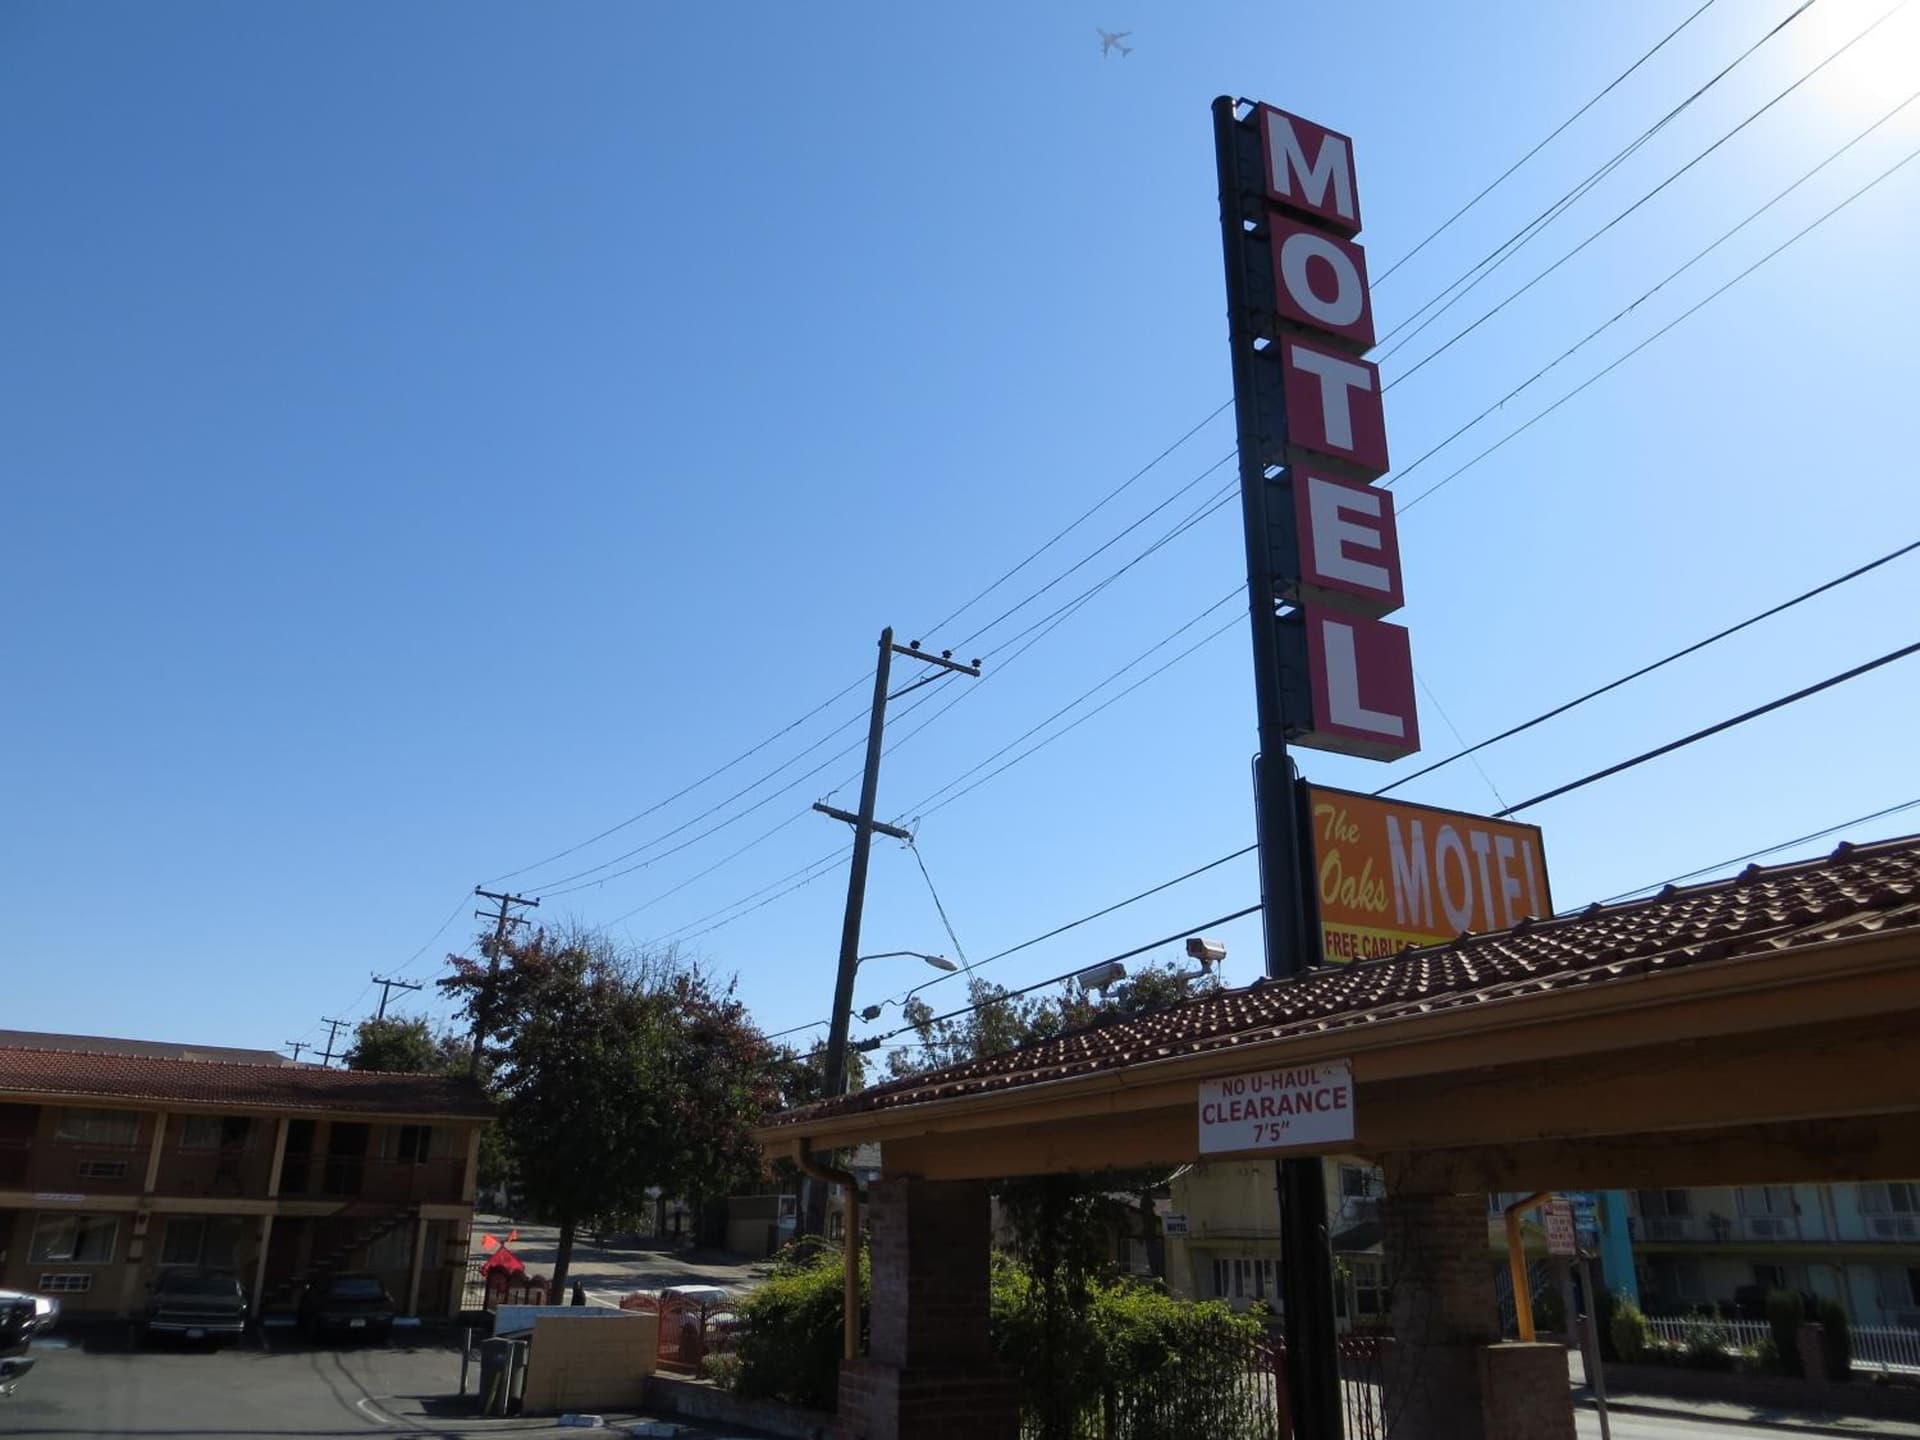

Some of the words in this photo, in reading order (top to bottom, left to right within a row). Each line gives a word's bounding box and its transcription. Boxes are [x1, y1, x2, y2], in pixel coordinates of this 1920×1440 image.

[1267, 110, 1405, 738] MOTEL
[1314, 803, 1360, 843] The
[1320, 849, 1388, 912] Oaks
[1324, 930, 1358, 958] FREE
[1222, 1078, 1245, 1097] NO
[1252, 1067, 1320, 1093] U-HAUL
[1202, 1086, 1347, 1125] CLEARANCE
